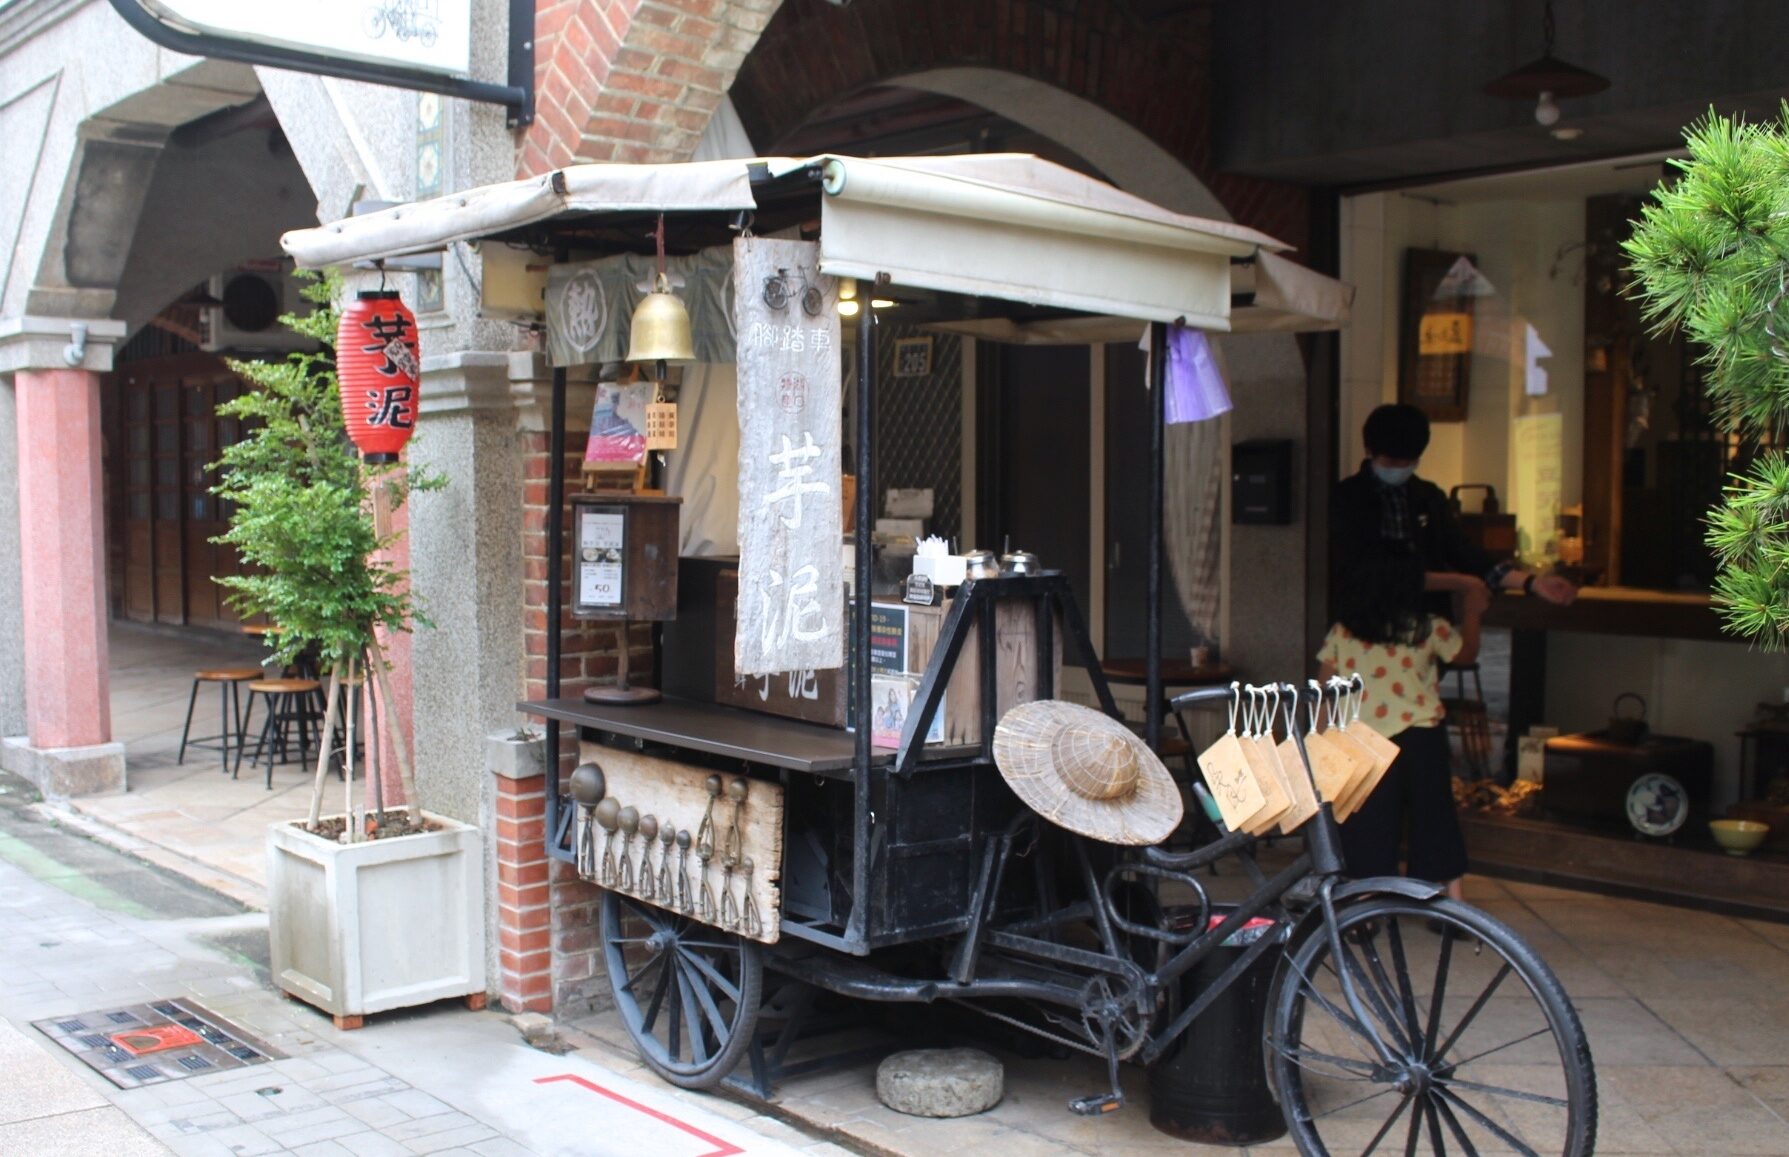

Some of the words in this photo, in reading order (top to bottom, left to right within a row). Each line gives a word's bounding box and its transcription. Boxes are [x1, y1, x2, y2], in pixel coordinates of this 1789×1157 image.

[746, 322, 832, 353] 腳踏車
[761, 432, 830, 655] 芋泥
